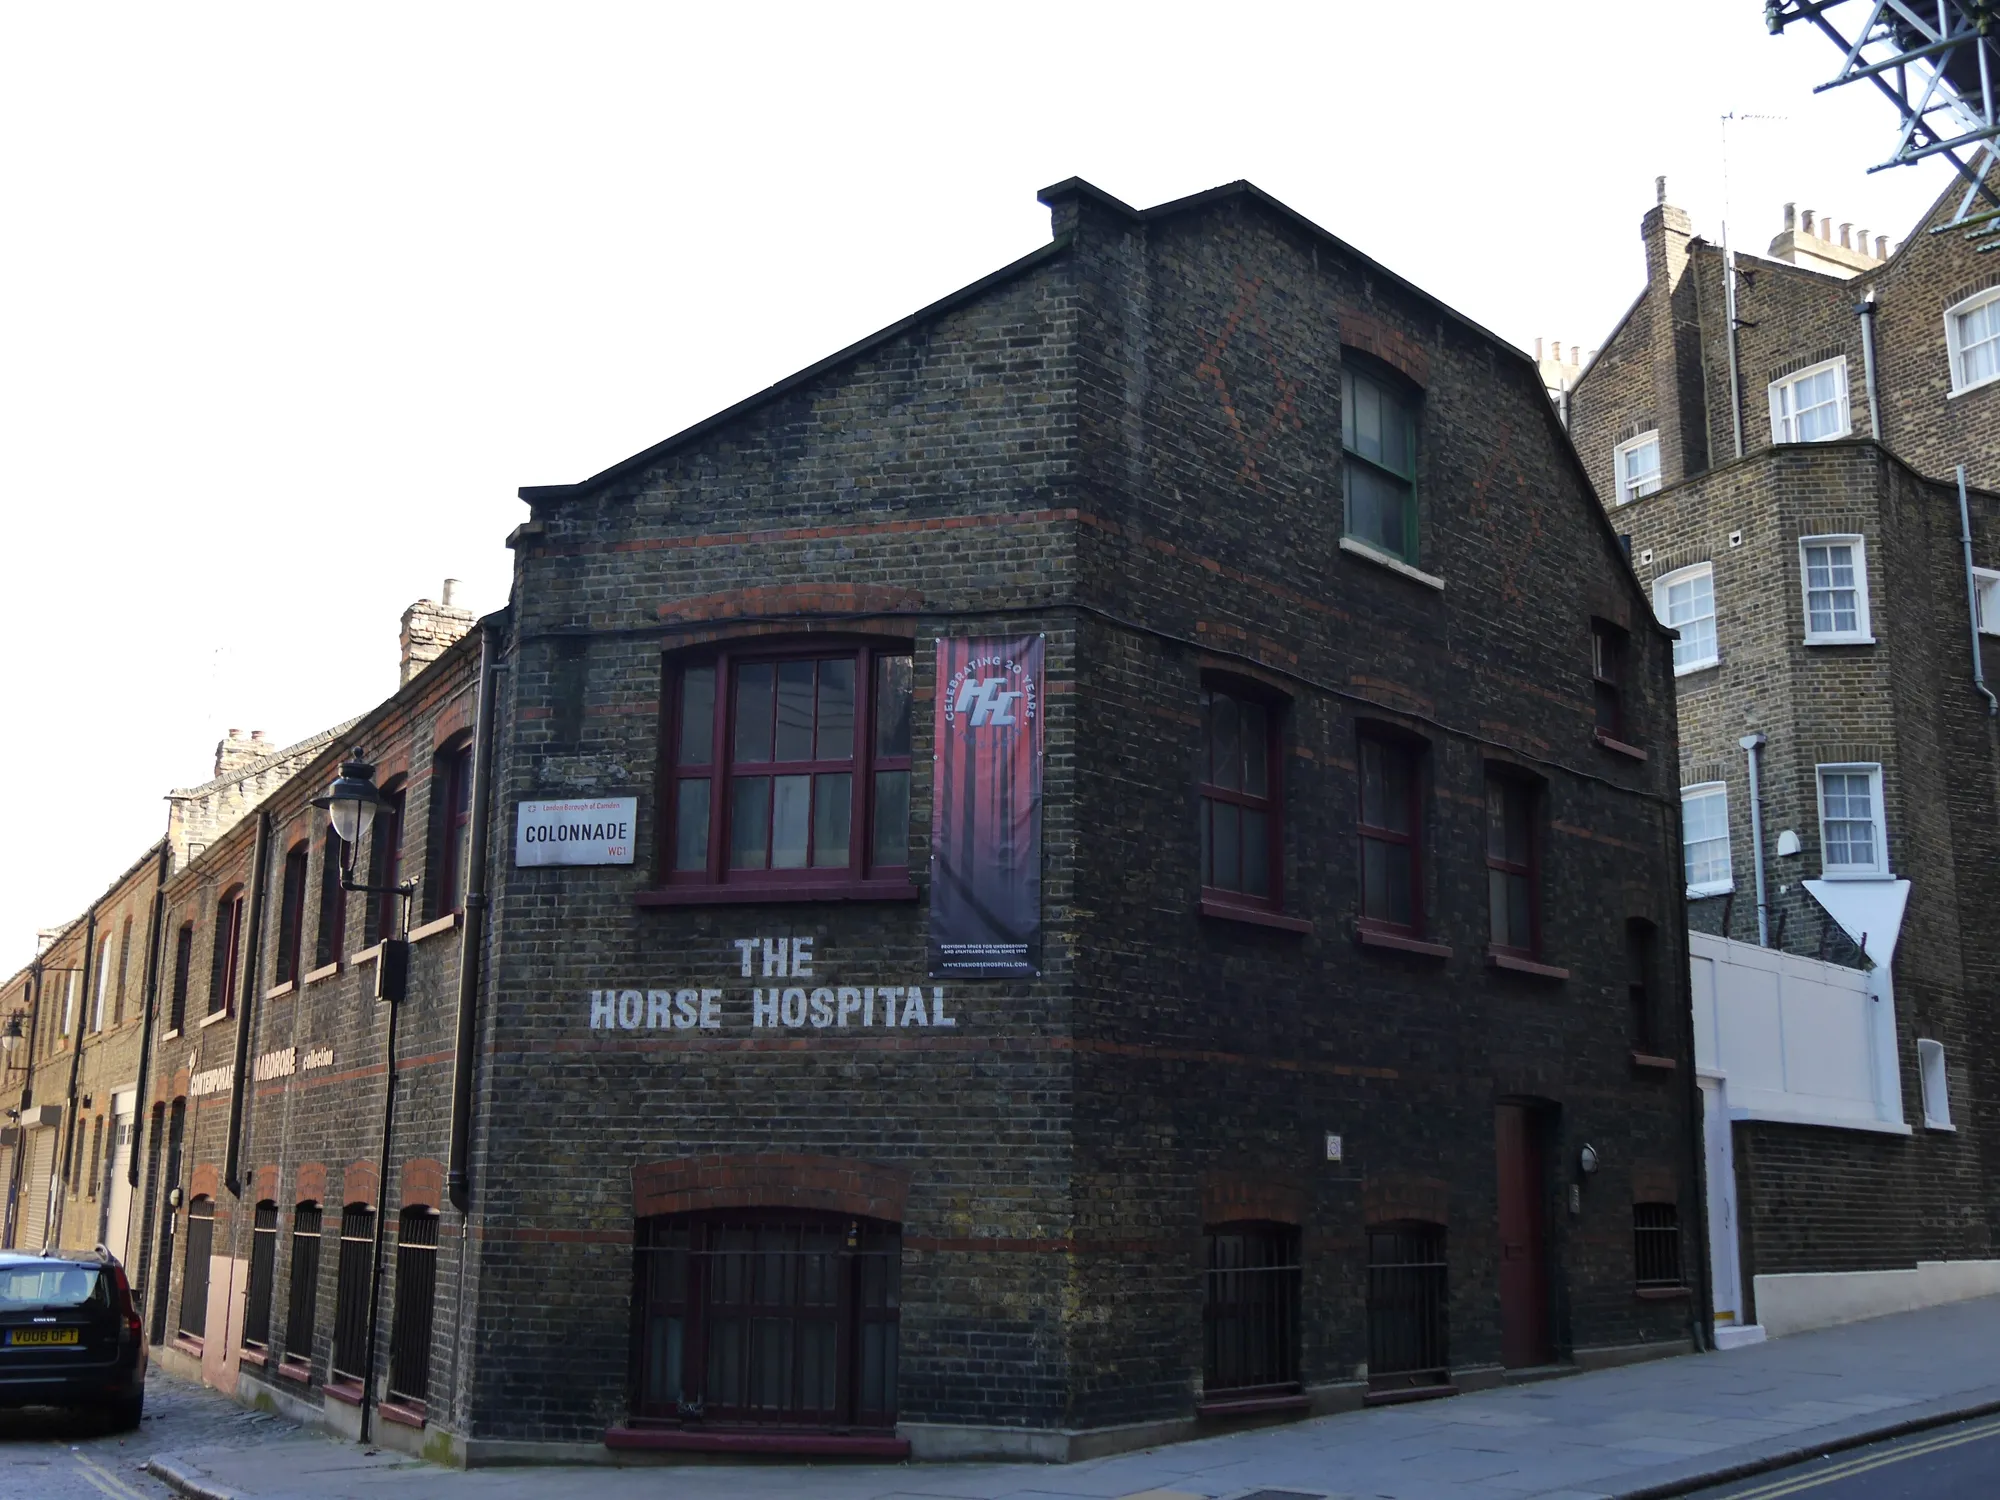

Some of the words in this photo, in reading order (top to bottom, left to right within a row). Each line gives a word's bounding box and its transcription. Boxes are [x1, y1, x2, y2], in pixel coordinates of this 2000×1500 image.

[944, 656, 1001, 721] CELEBRATING
[1005, 660, 1022, 674] 20
[1022, 674, 1036, 718] YEARS
[543, 803, 564, 811] London
[564, 803, 588, 812] Borough
[596, 802, 620, 810] Camden
[525, 822, 627, 843] COLONNADE
[608, 846, 627, 856] WC1
[734, 937, 814, 978] THE
[590, 988, 723, 1030] HORSE
[752, 986, 956, 1029] HOSPITAL
[191, 1064, 234, 1096] CONTEMPORAR
[253, 1046, 295, 1082] WARDROBE
[303, 1046, 334, 1071] collection
